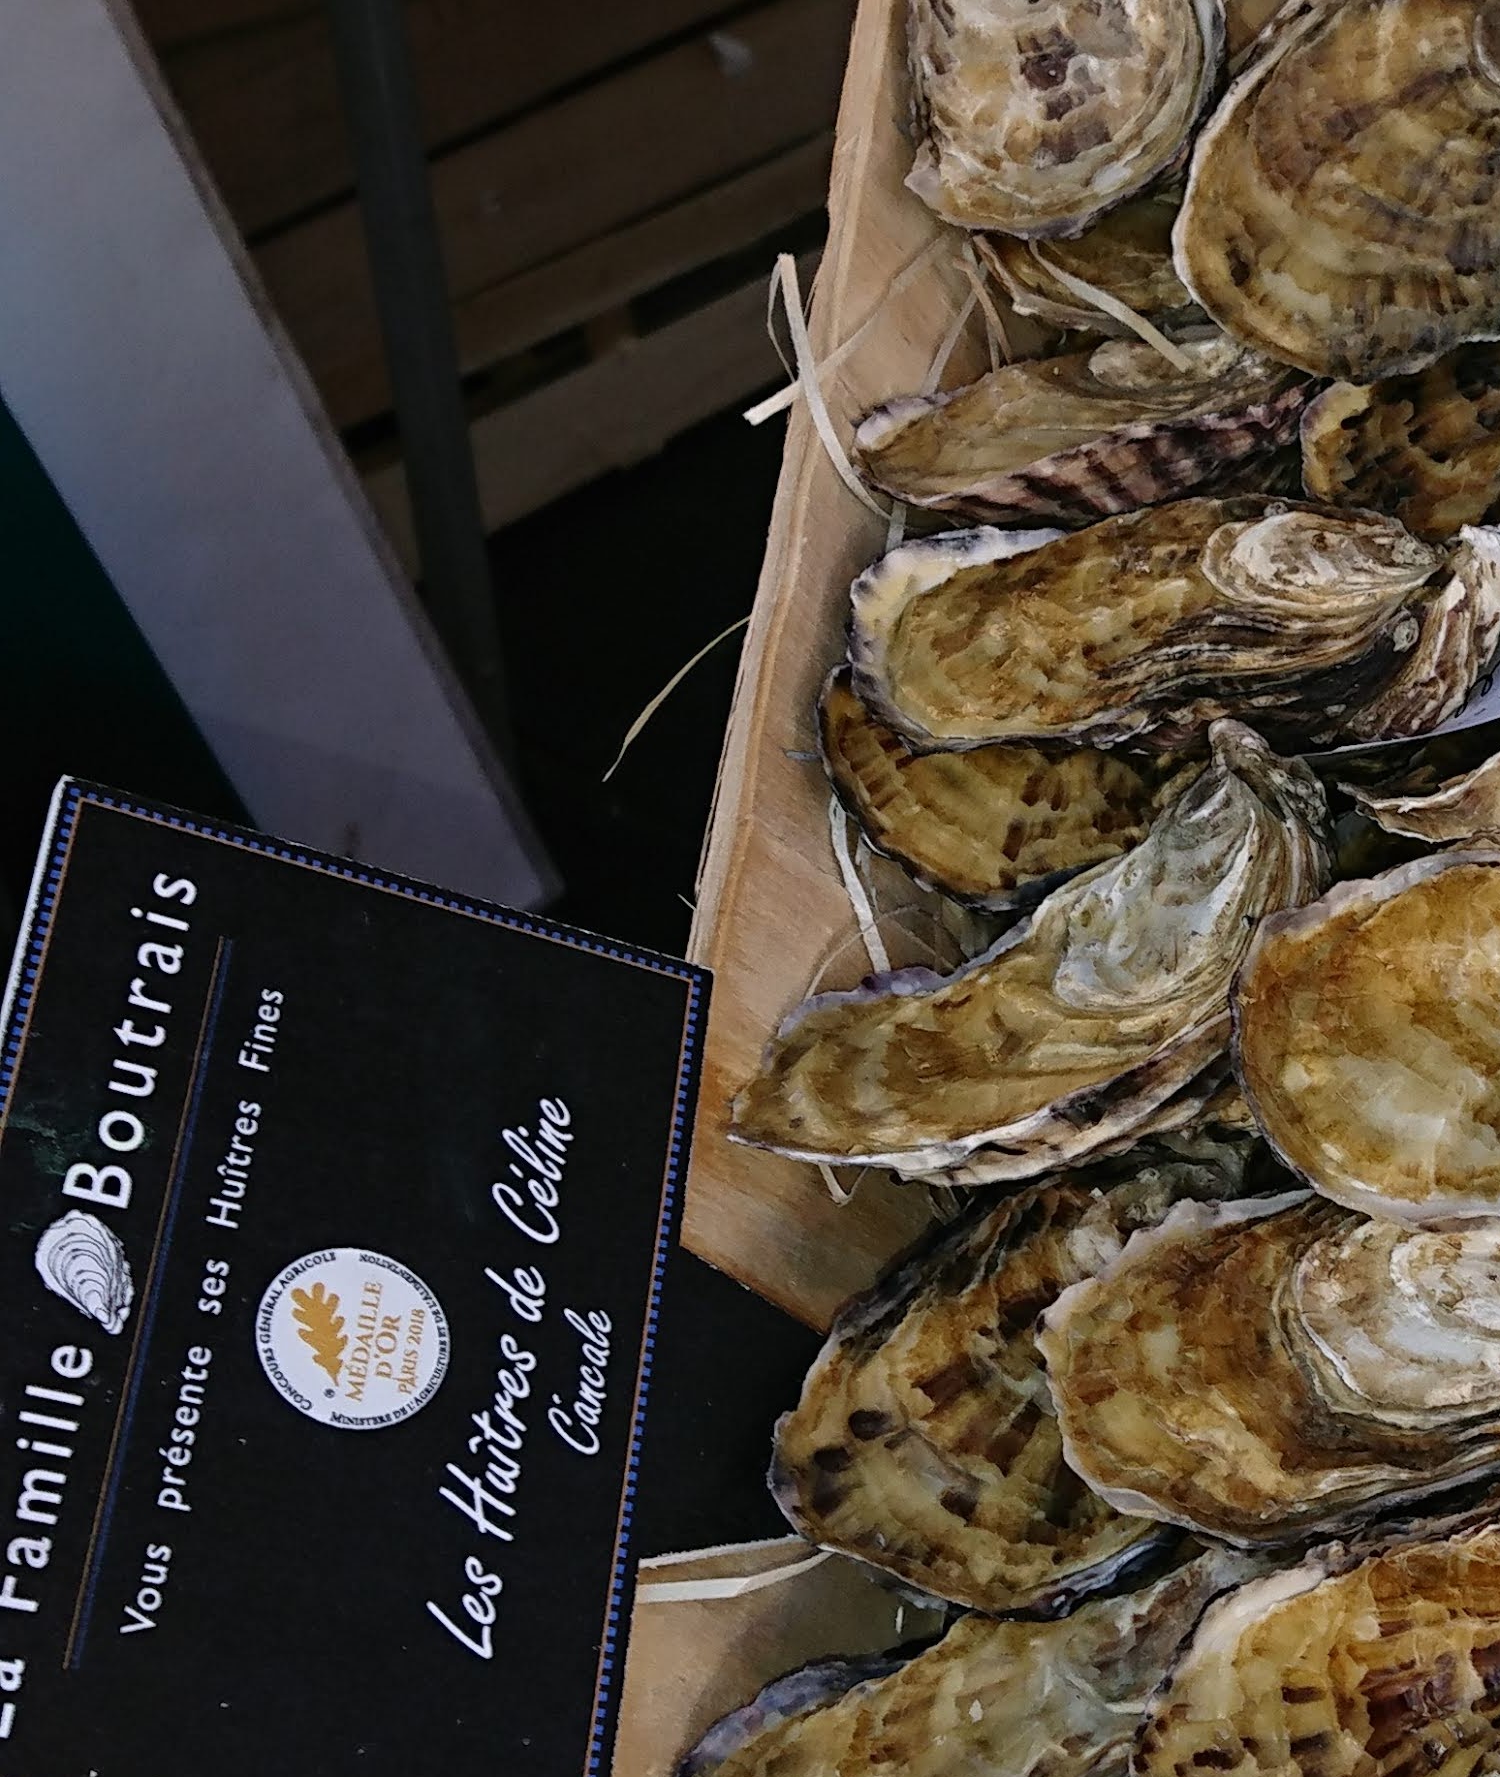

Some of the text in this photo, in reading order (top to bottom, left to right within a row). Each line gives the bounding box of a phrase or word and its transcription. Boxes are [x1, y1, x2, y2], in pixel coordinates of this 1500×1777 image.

[0, 1344, 94, 1613] Famille
[60, 872, 198, 1210] Boutrais
[118, 987, 285, 1634] Vous présente ses Huîtres Fines
[345, 1281, 383, 1401] MÉDAILLE
[393, 1308, 425, 1395] PARIS 2018
[425, 1096, 575, 1661] Les Huîtres de Céline
